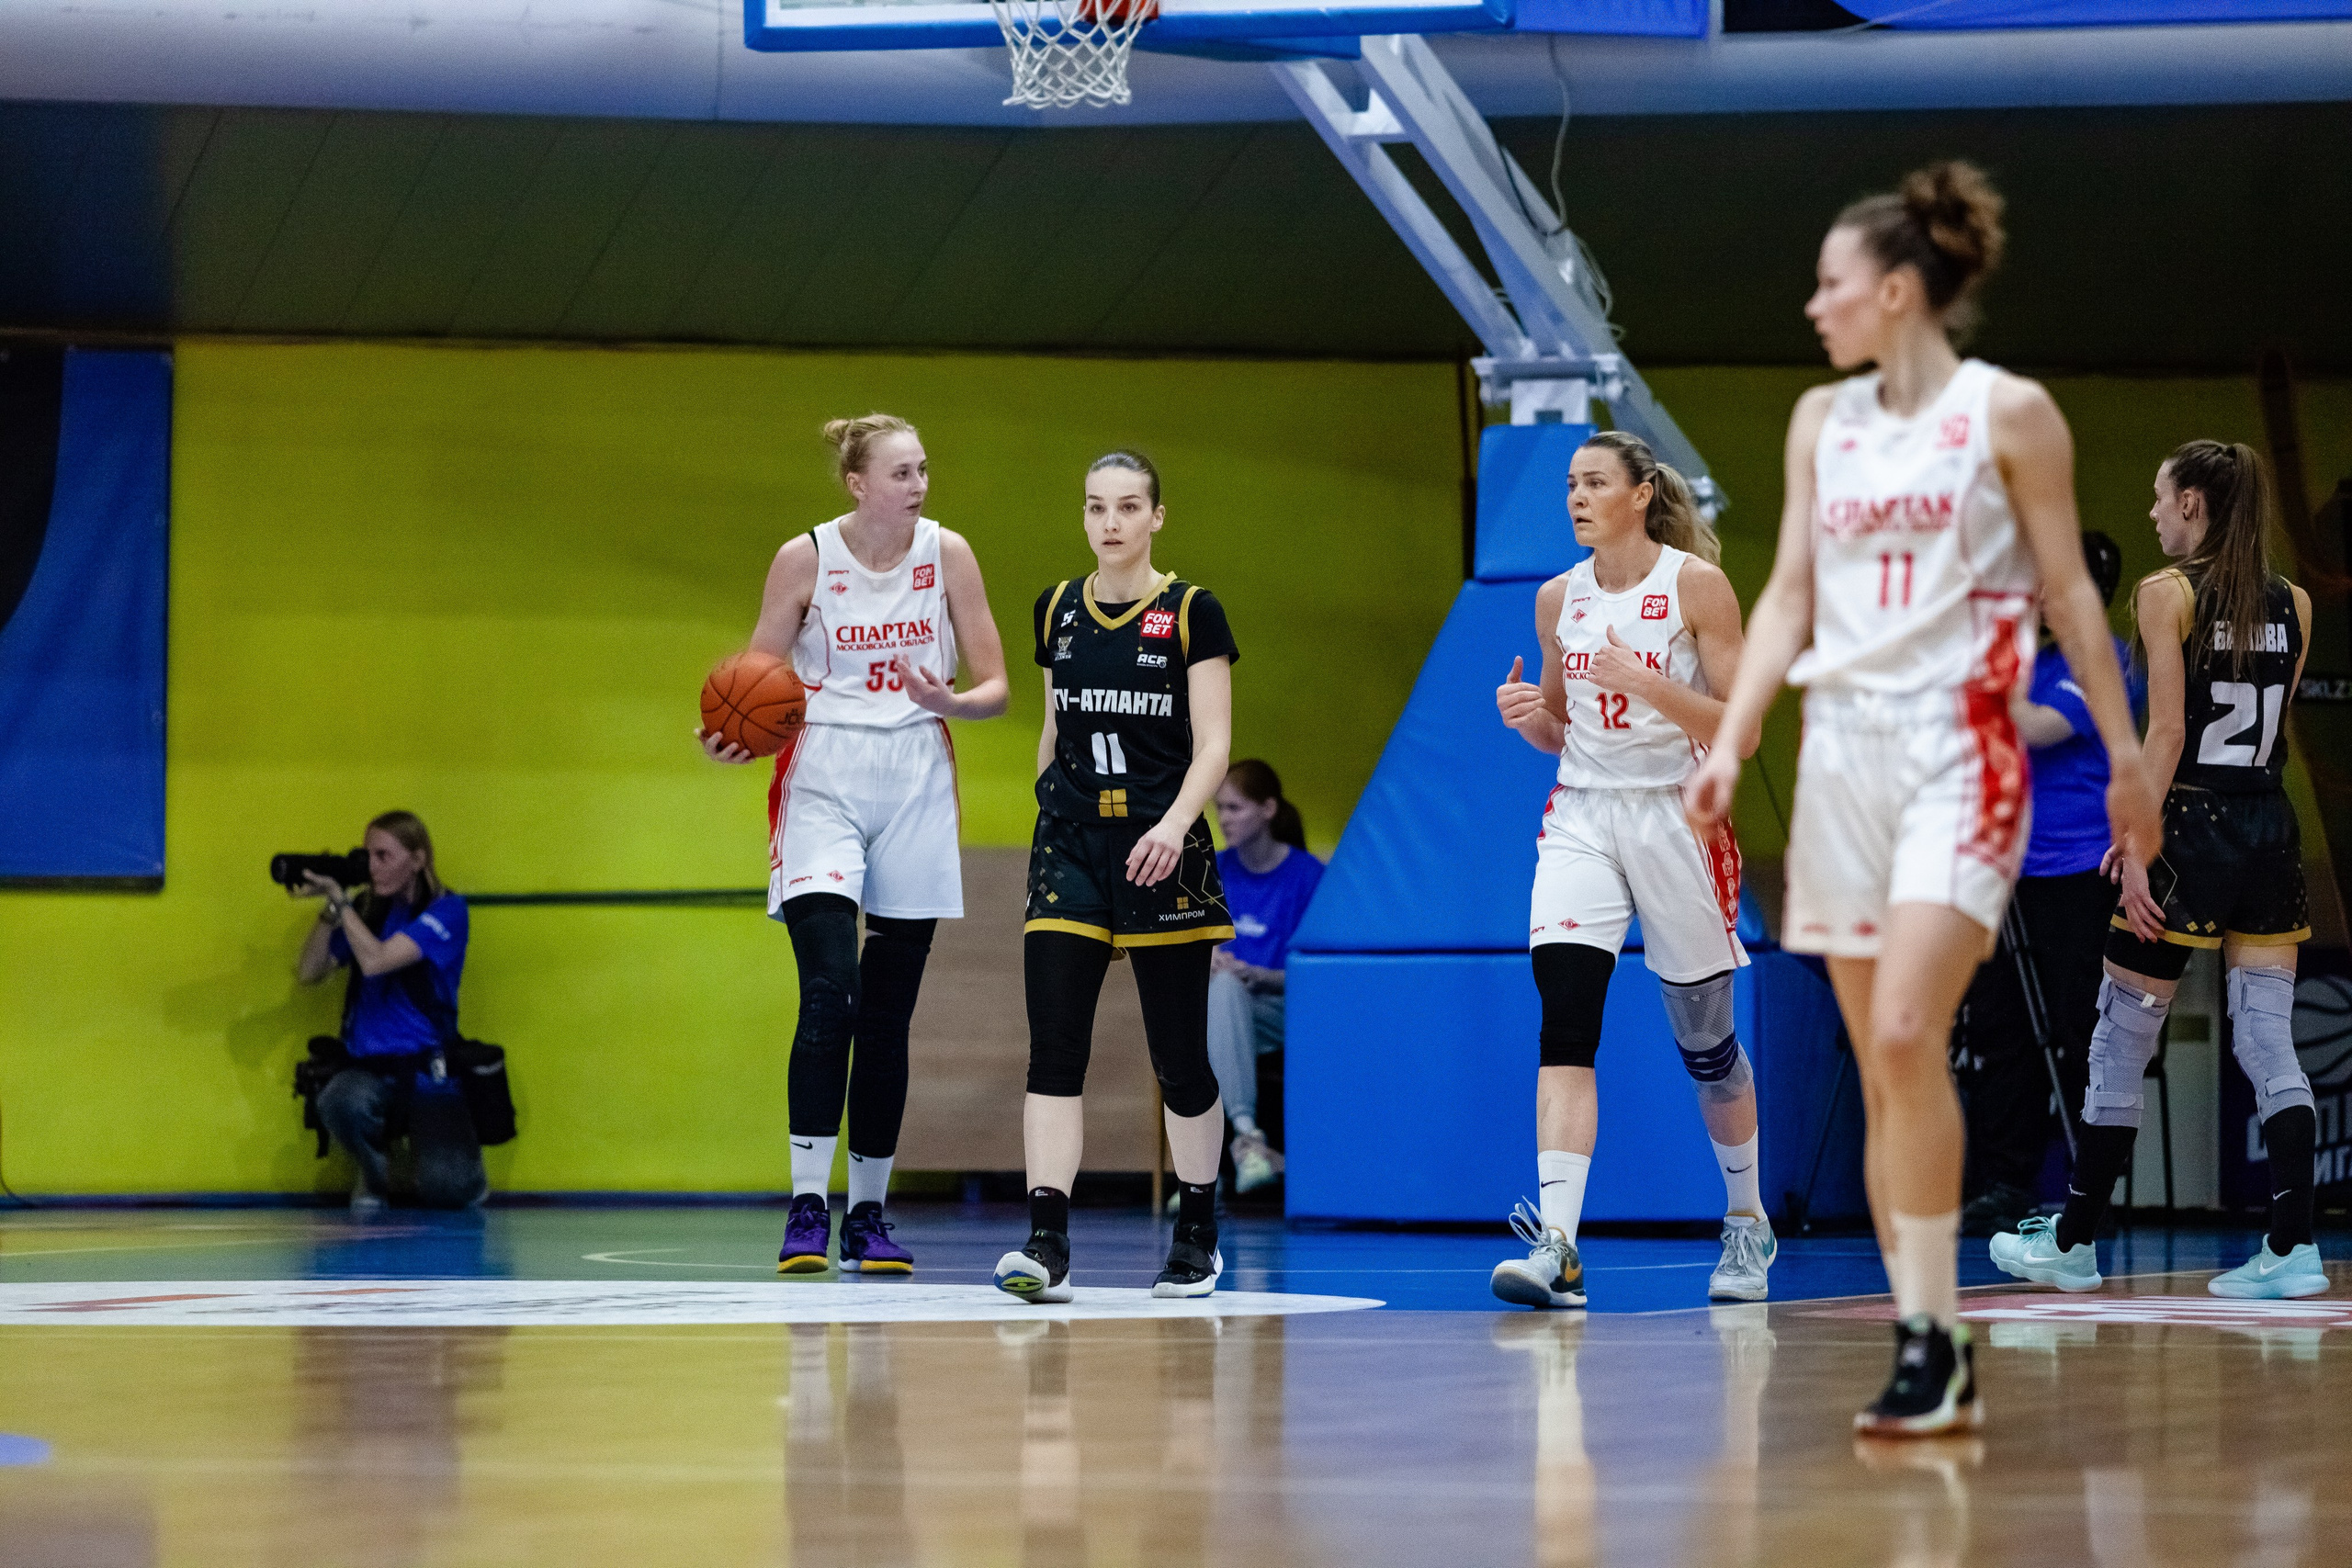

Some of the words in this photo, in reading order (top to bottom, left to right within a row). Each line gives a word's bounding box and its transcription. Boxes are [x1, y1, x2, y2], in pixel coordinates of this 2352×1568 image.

[914, 567, 933, 578] FON
[1878, 550, 1914, 608] 11
[914, 576, 933, 588] BET
[1644, 597, 1667, 607] FON
[1643, 606, 1666, 616] BET
[1144, 613, 1173, 625] FON
[835, 617, 933, 643] СПАРТАК
[1142, 624, 1171, 635] BET
[836, 641, 897, 651] МОСКОВСКАЯ
[899, 635, 935, 648] ОБЛАСТЬ
[865, 660, 903, 693] 55
[1595, 692, 1632, 729] 12
[2197, 681, 2285, 766] 21
[1091, 731, 1126, 774] 11
[1159, 909, 1205, 921] ХИМПРОМ
